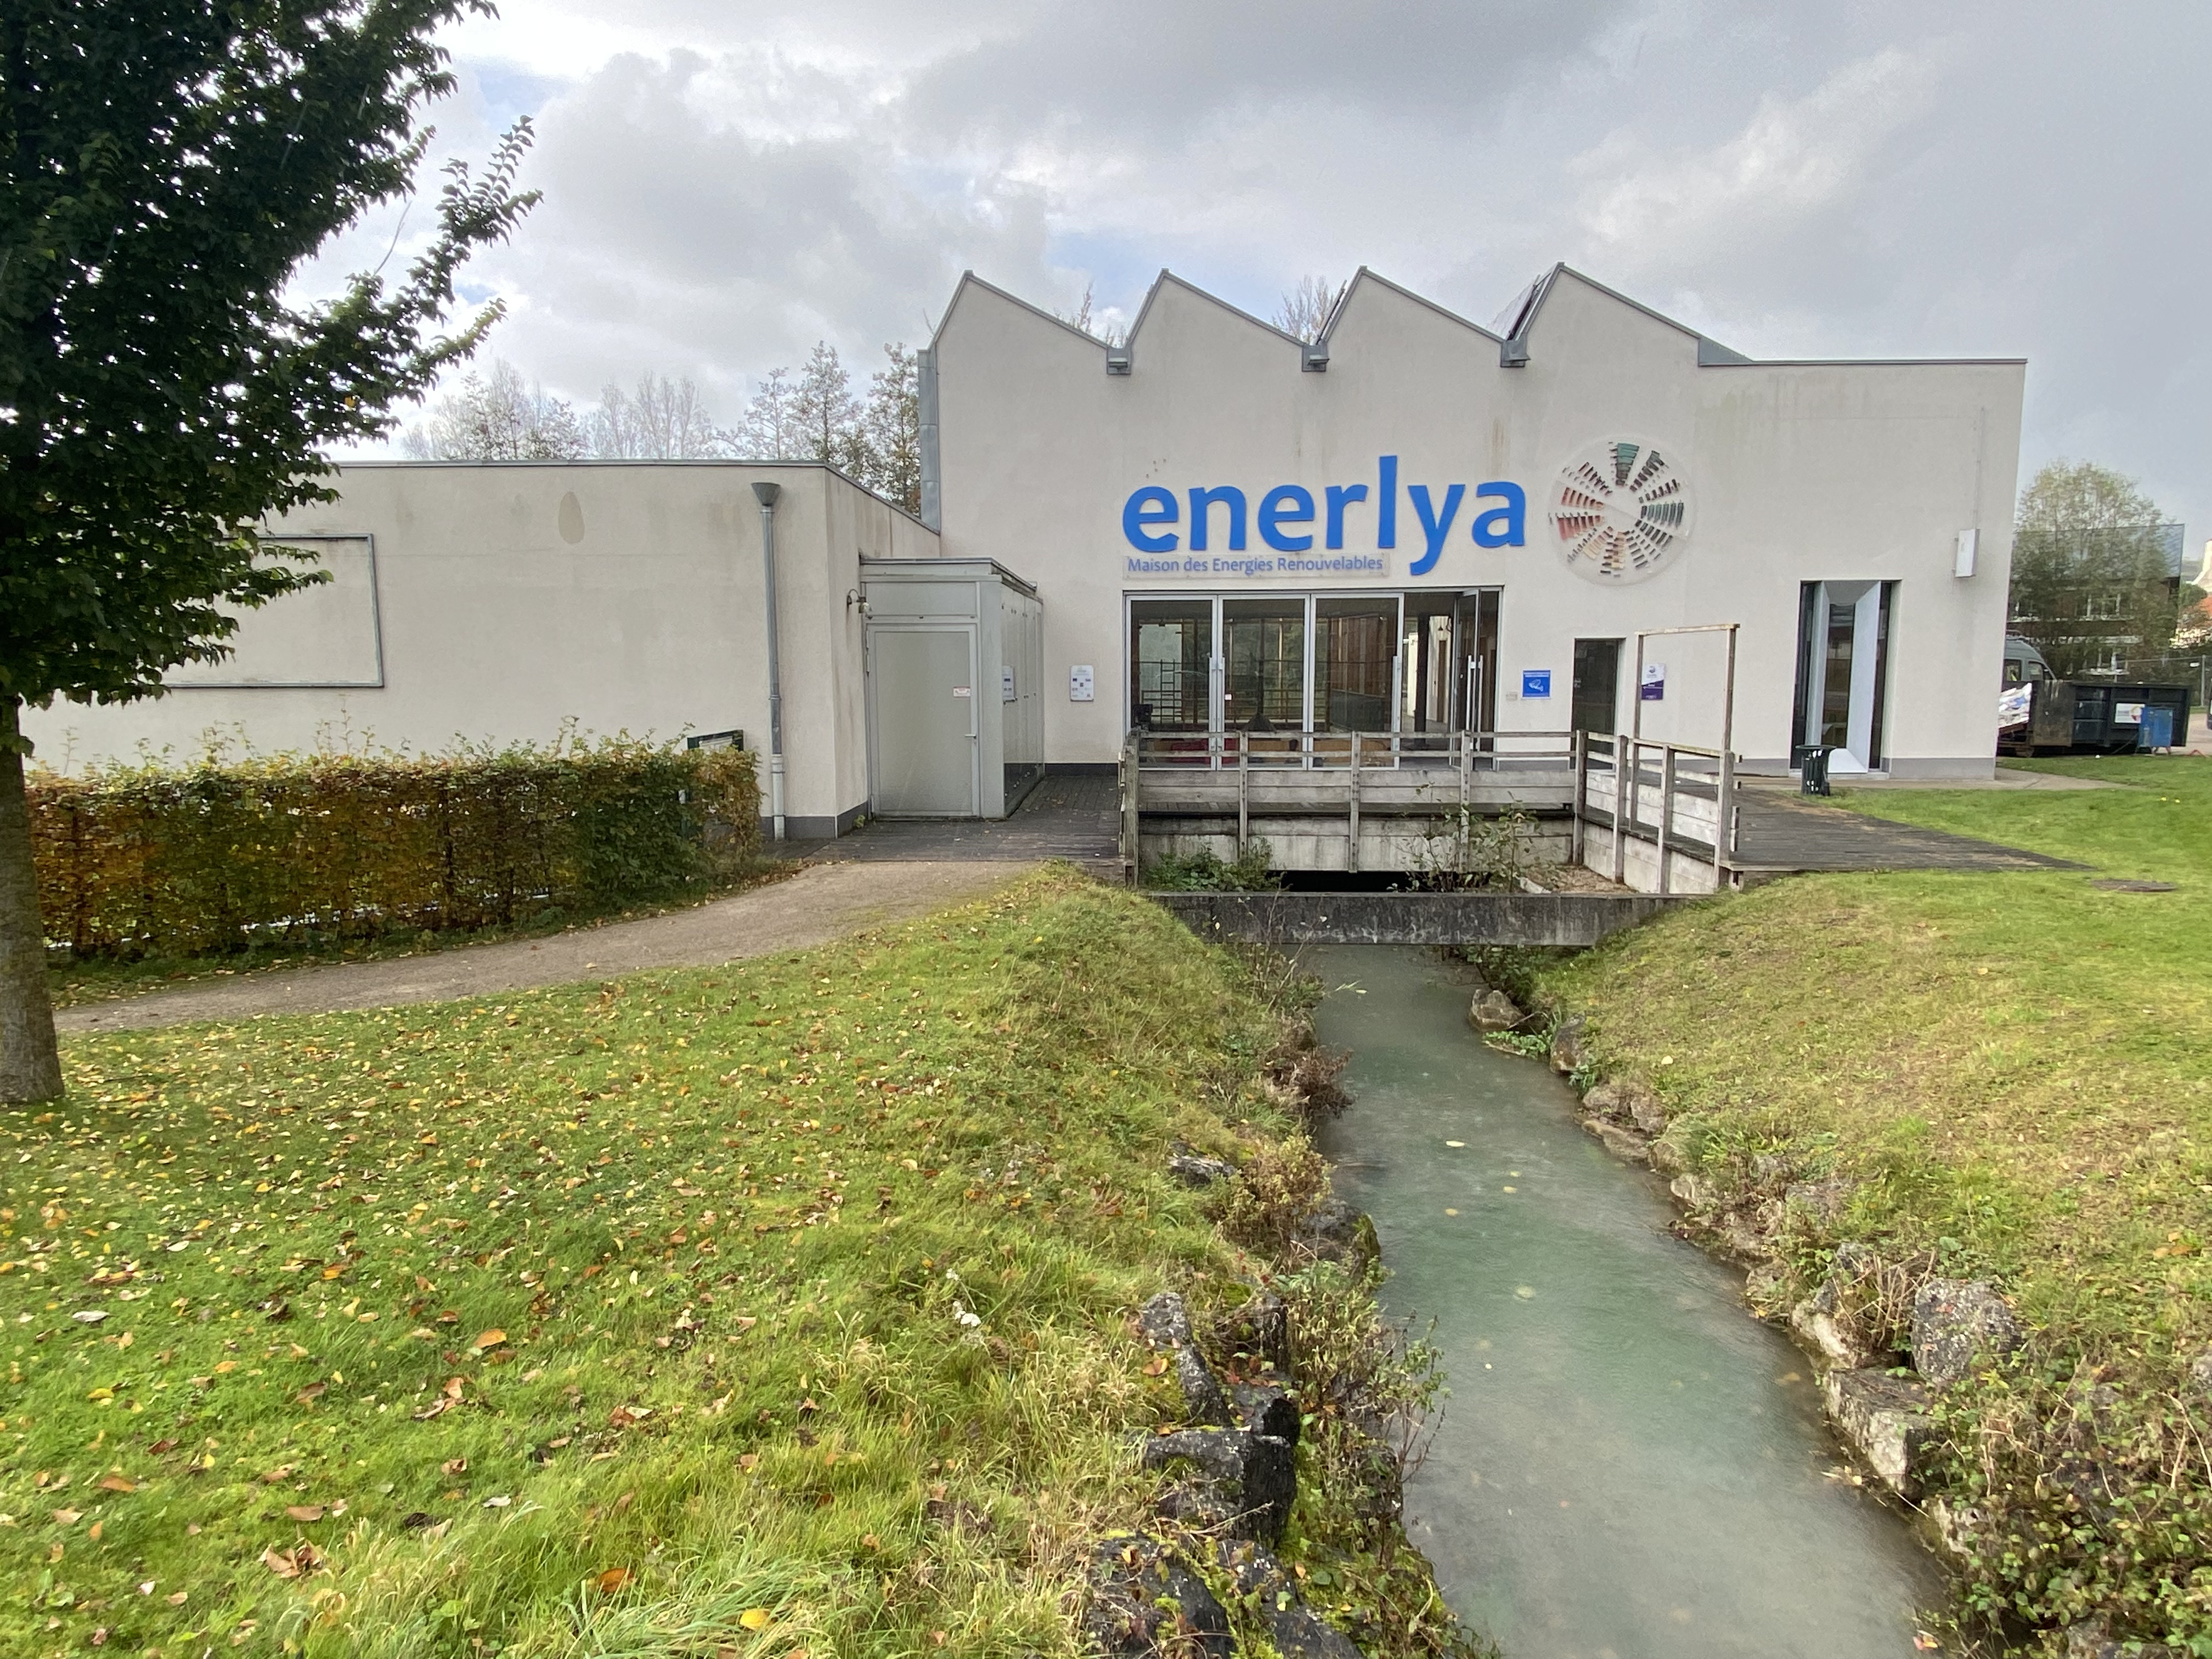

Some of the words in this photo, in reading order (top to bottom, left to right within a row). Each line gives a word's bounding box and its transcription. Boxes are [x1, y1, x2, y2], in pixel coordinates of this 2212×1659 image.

[1122, 455, 1526, 575] enerlya
[1128, 558, 1179, 572] Maison
[1183, 557, 1208, 572] des
[1212, 557, 1273, 575] Energies
[1277, 555, 1383, 571] Renouvelables
